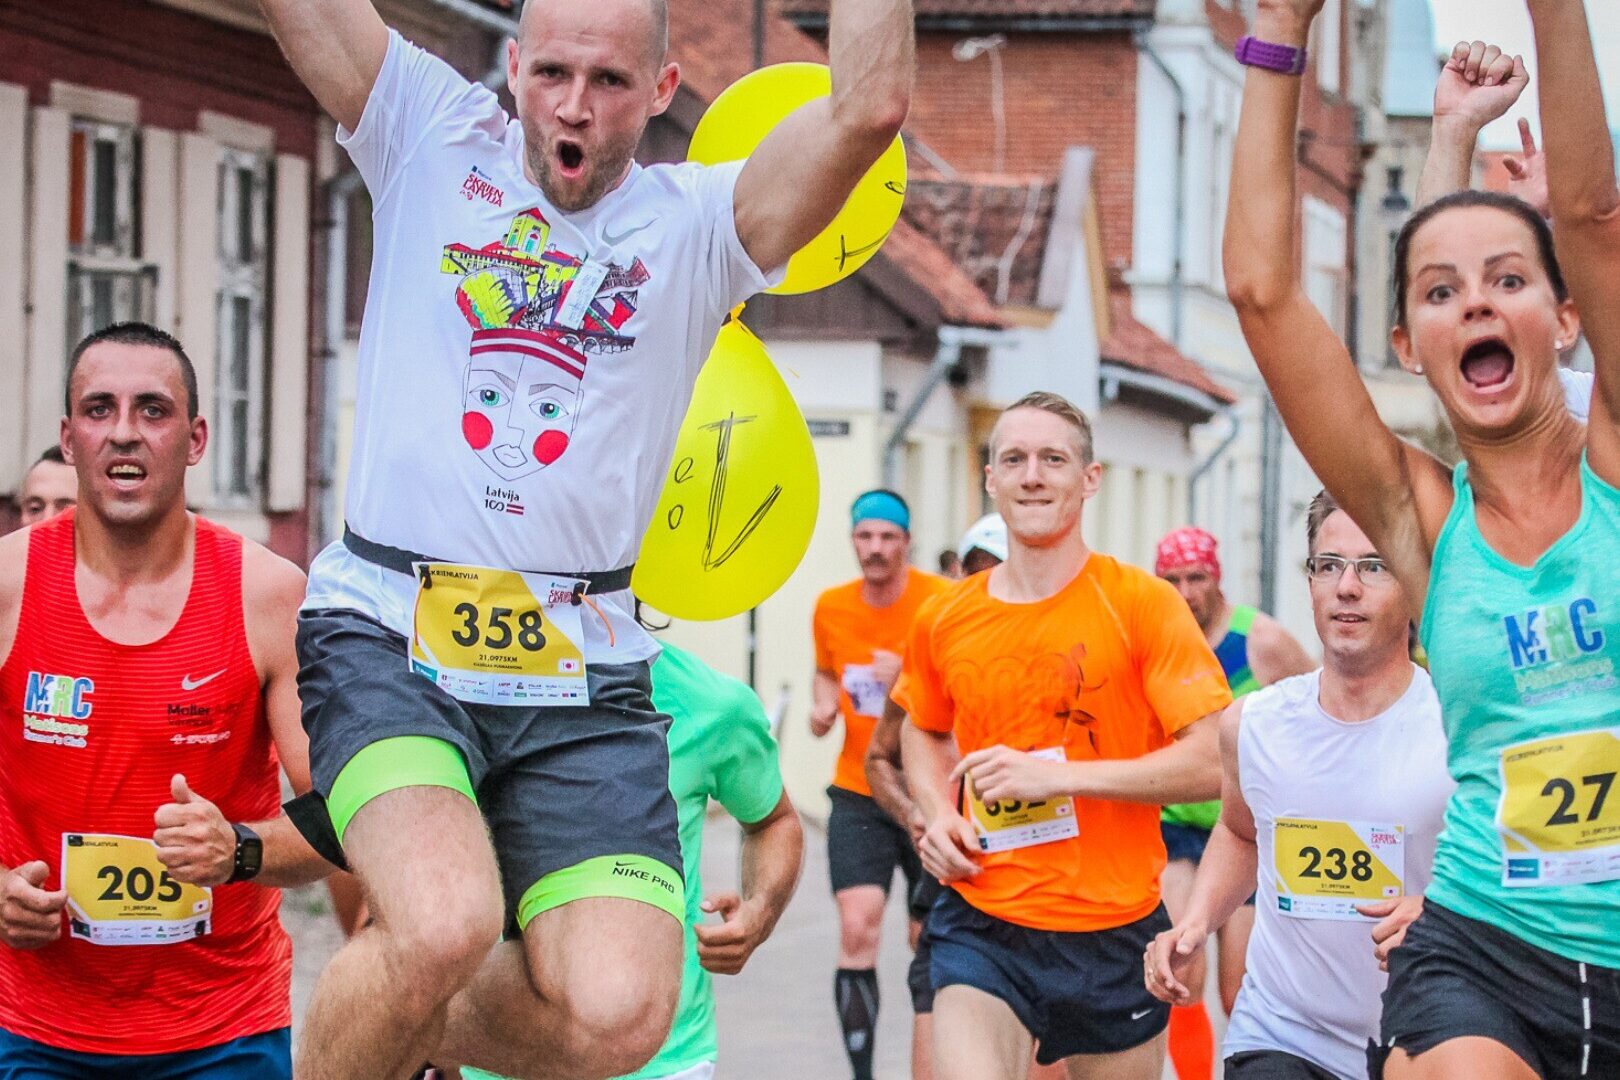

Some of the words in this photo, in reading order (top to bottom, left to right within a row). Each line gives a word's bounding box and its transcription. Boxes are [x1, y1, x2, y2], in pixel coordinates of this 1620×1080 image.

[486, 485, 520, 502] Latvija
[451, 602, 547, 652] 358
[1503, 597, 1606, 671] MRC
[24, 671, 95, 719] MRC
[1540, 772, 1618, 827] 27
[97, 865, 182, 902] 205
[613, 867, 650, 880] NIKE
[652, 875, 675, 894] PRO
[1298, 846, 1373, 882] 238
